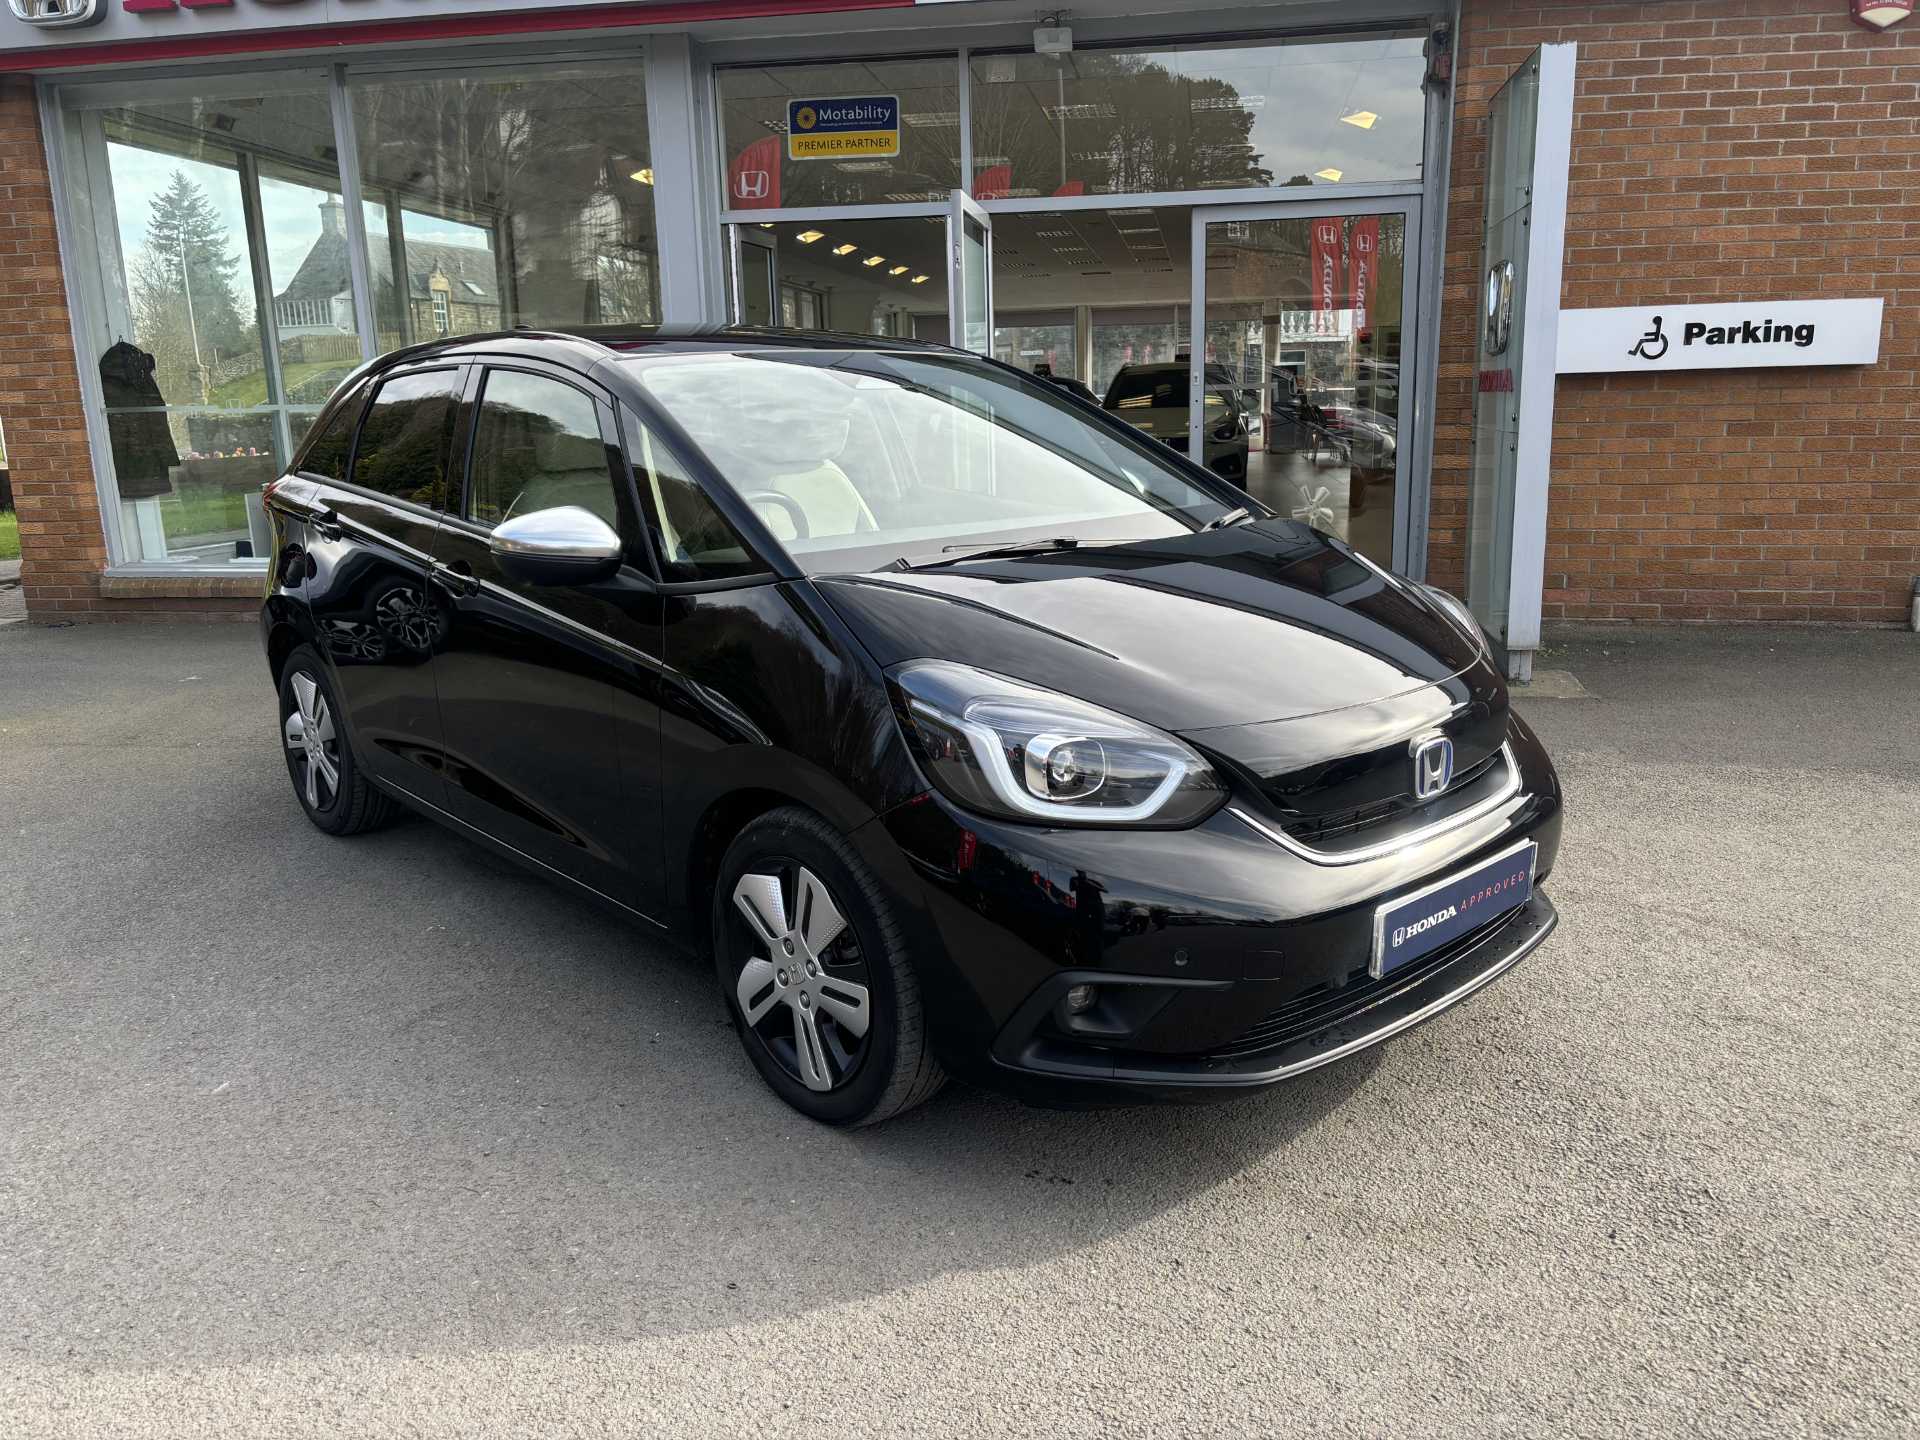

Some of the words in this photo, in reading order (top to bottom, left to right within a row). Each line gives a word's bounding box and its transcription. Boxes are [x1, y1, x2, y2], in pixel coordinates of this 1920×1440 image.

[819, 105, 891, 122] Motability
[798, 140, 842, 151] PREMIER
[846, 138, 890, 149] PARTNER
[1683, 319, 1815, 347] Parking
[1406, 906, 1457, 939] HONDA
[1460, 871, 1525, 912] APPROVED
